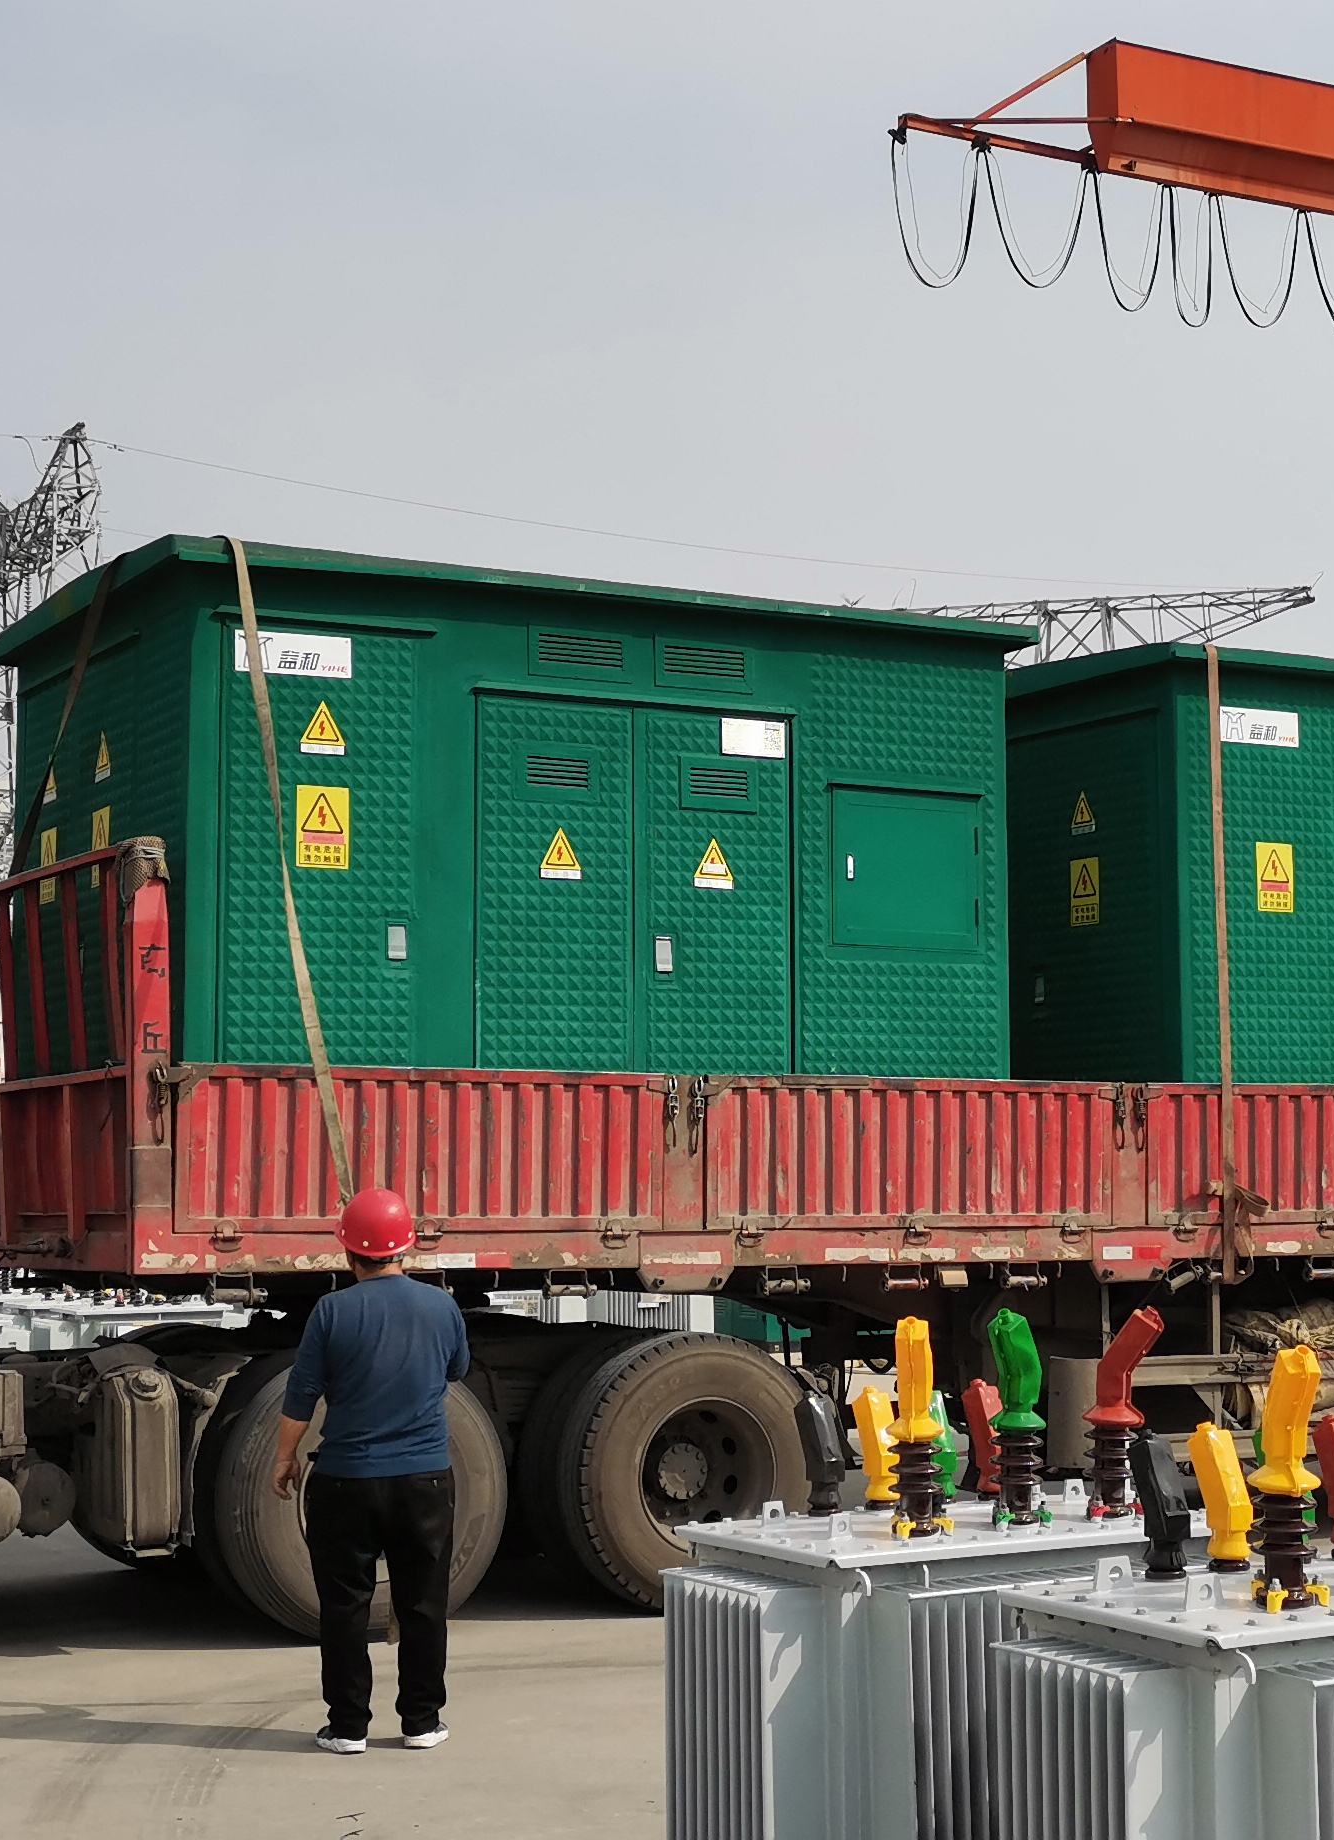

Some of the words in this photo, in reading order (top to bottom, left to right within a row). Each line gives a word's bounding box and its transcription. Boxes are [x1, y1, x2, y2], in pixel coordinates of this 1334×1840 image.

[277, 650, 321, 671] 益和
[1249, 724, 1278, 741] 益和
[303, 844, 341, 853] 有电危险
